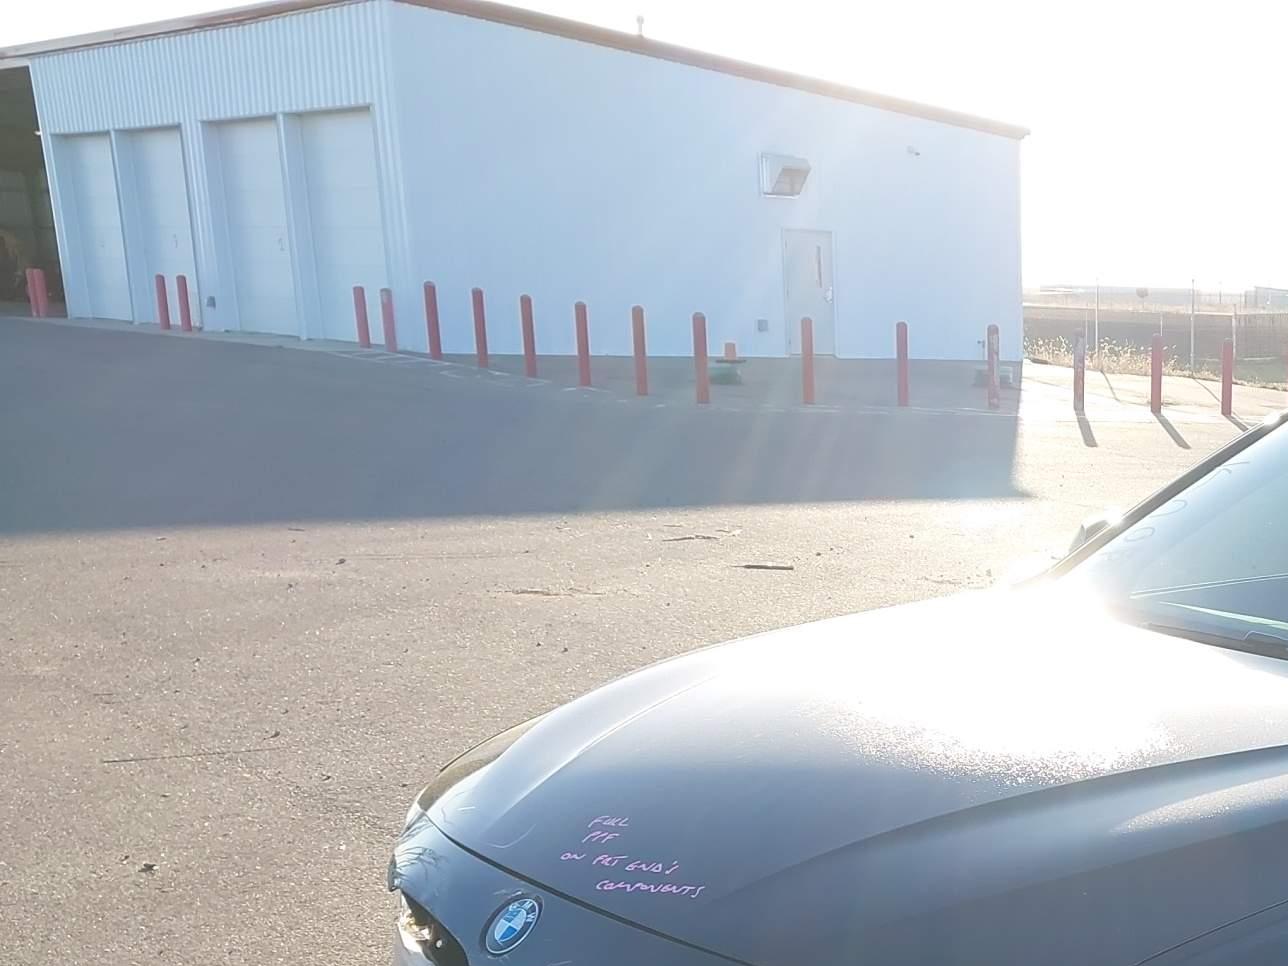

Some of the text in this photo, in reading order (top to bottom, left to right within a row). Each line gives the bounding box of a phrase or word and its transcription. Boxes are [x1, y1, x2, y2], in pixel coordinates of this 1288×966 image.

[588, 815, 629, 828] FULL
[560, 851, 586, 861] ON
[596, 879, 705, 898] COMPONENTS
